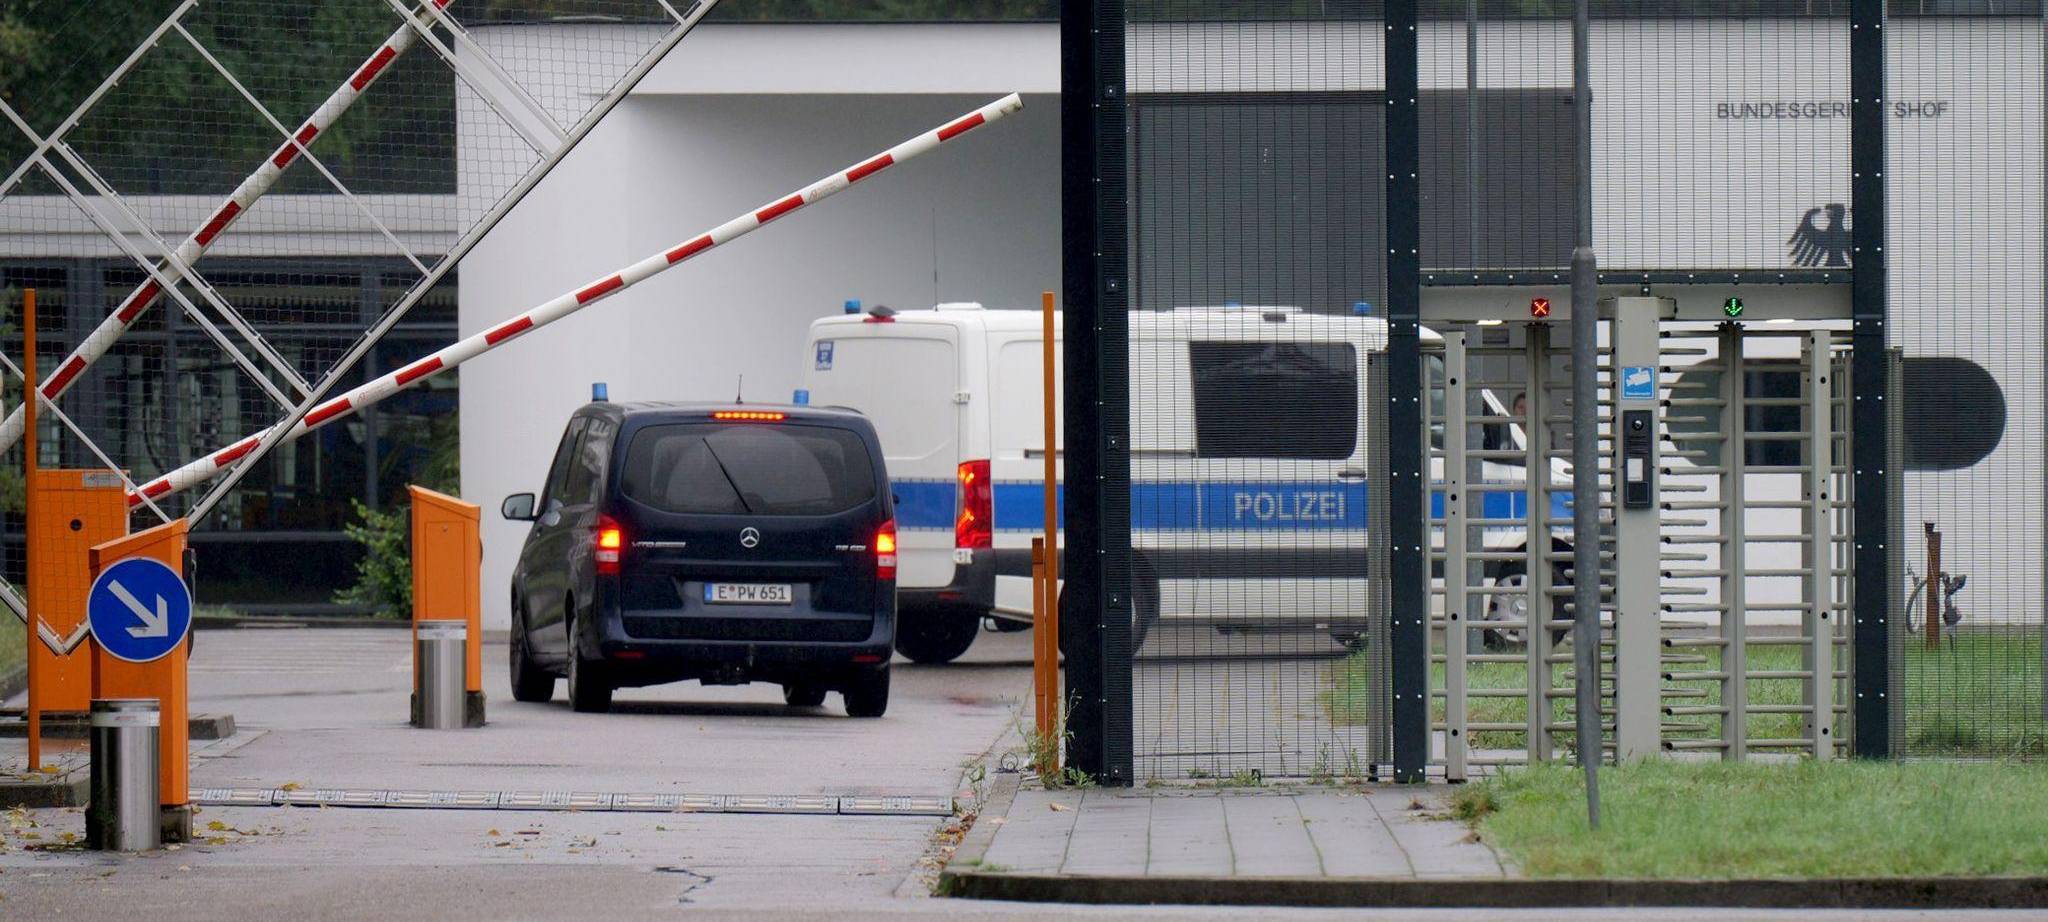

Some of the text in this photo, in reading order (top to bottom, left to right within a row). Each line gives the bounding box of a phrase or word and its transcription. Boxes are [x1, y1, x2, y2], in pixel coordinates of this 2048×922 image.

[1717, 102, 1948, 119] BUNDESGERISHOF
[1234, 491, 1345, 521] POLIZEI
[718, 585, 787, 600] E PW 651
